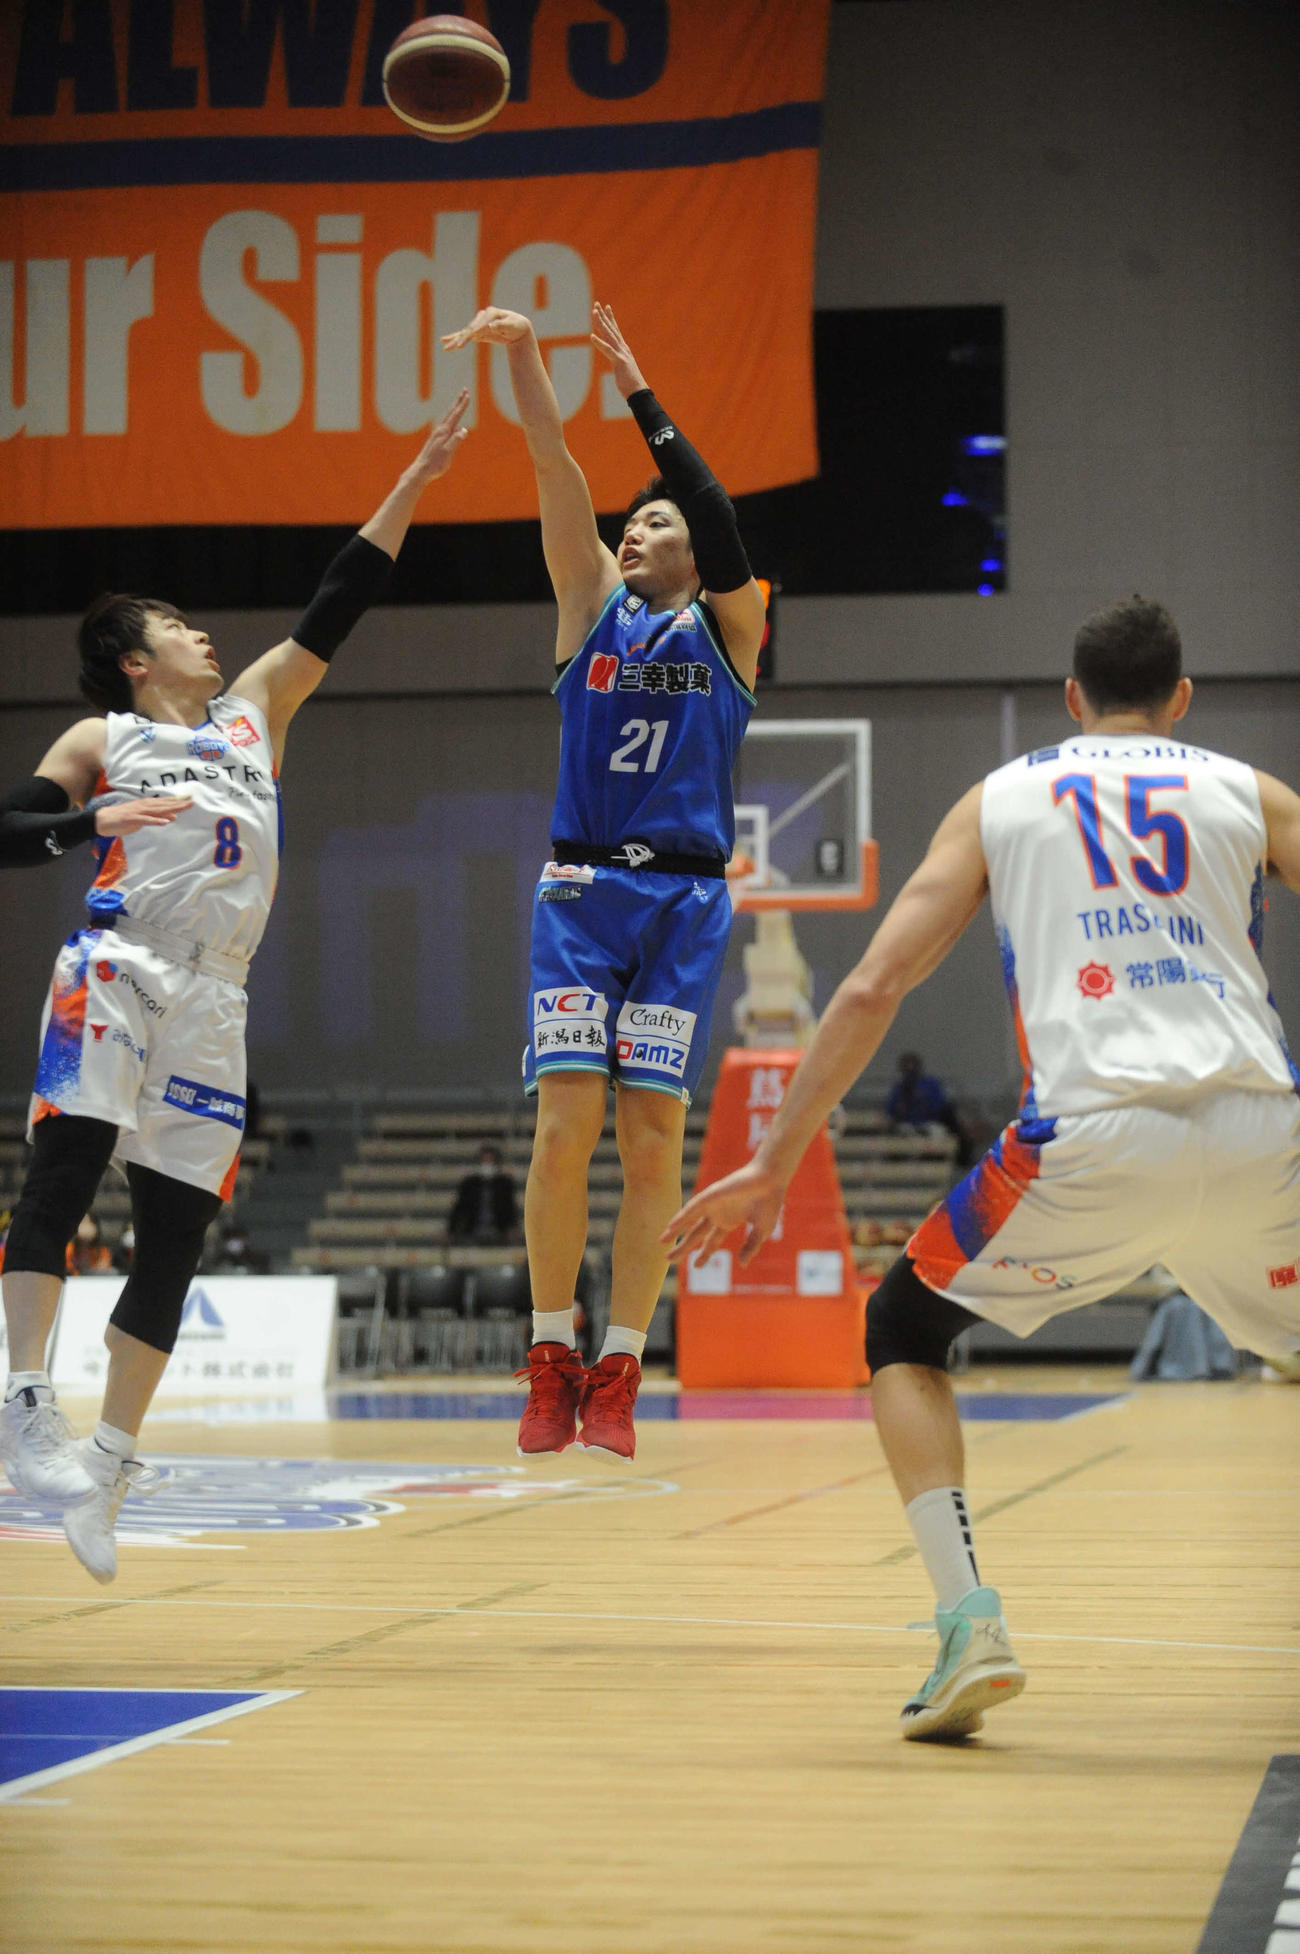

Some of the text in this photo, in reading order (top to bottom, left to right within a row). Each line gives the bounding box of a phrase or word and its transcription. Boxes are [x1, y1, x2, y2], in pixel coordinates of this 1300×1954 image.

[618, 662, 712, 696] 三幸製菓
[609, 718, 670, 773] 21
[214, 816, 242, 870] 8
[1050, 772, 1189, 897] 15
[537, 993, 598, 1016] NCT
[630, 1008, 687, 1036] Crafty
